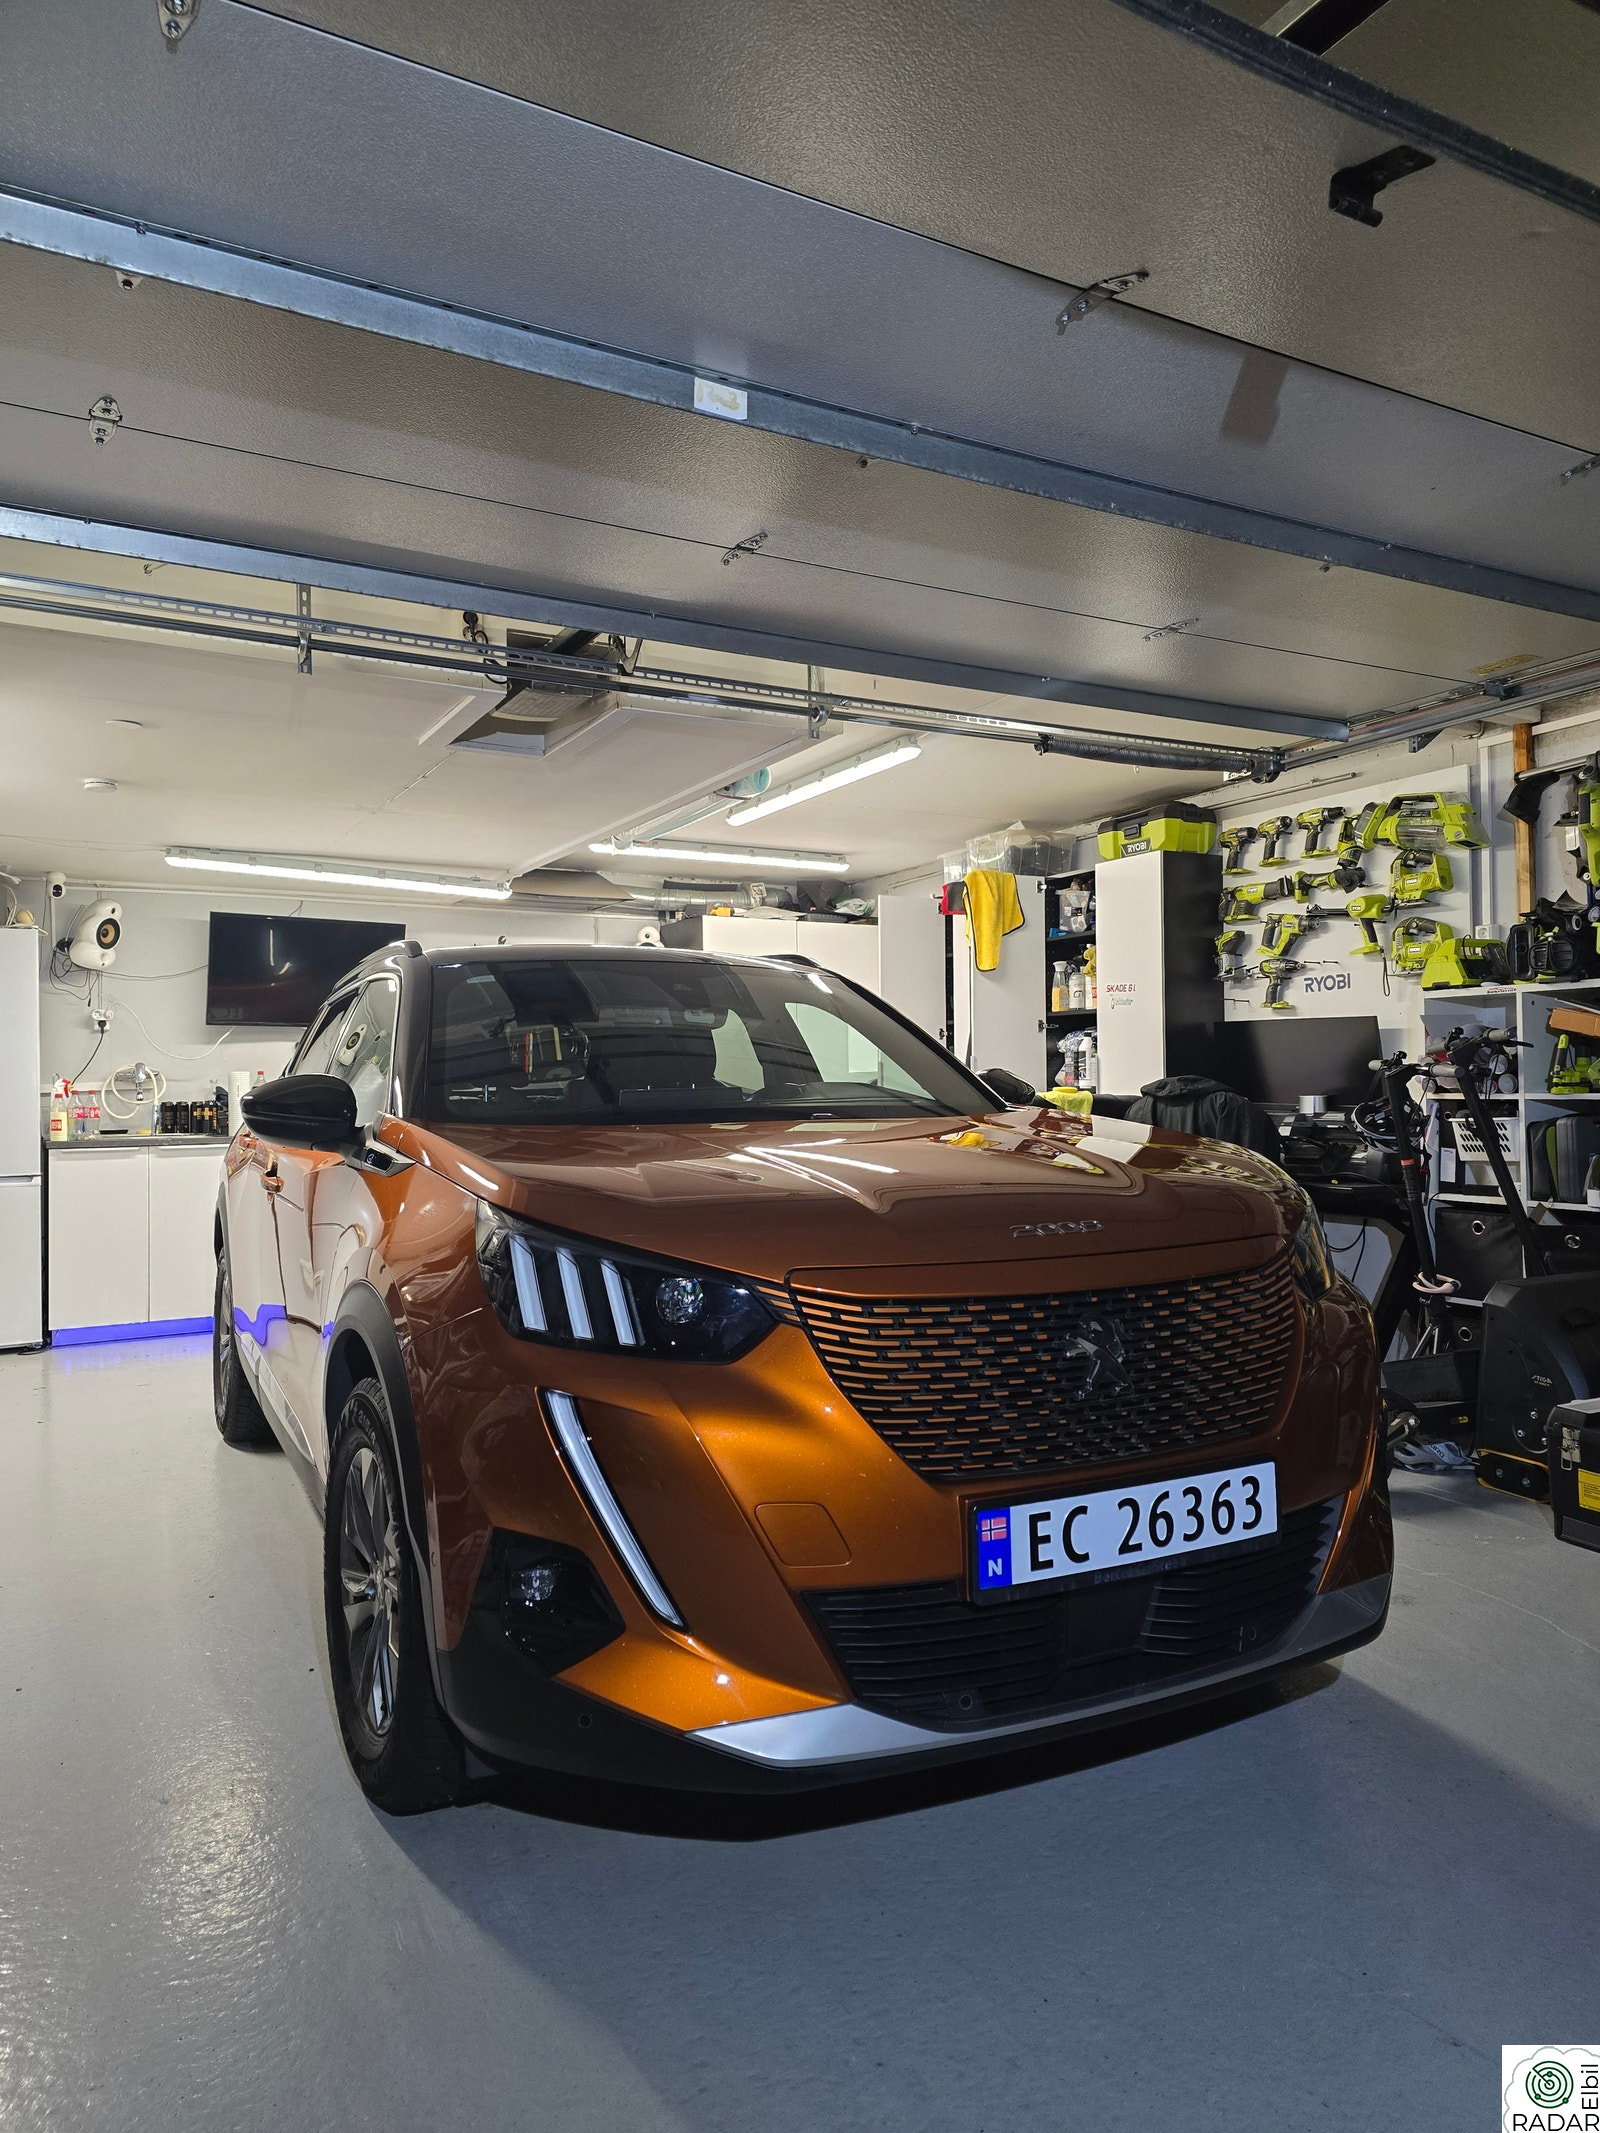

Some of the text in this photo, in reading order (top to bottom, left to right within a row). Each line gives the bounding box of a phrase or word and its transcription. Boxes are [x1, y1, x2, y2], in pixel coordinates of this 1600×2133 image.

[1127, 841, 1147, 853] RYOBI
[1106, 984, 1127, 992] SKADE
[1303, 972, 1351, 993] RYOBI
[1009, 1219, 1105, 1238] 2008
[1028, 1475, 1263, 1572] EC 26363
[987, 1557, 1003, 1577] N
